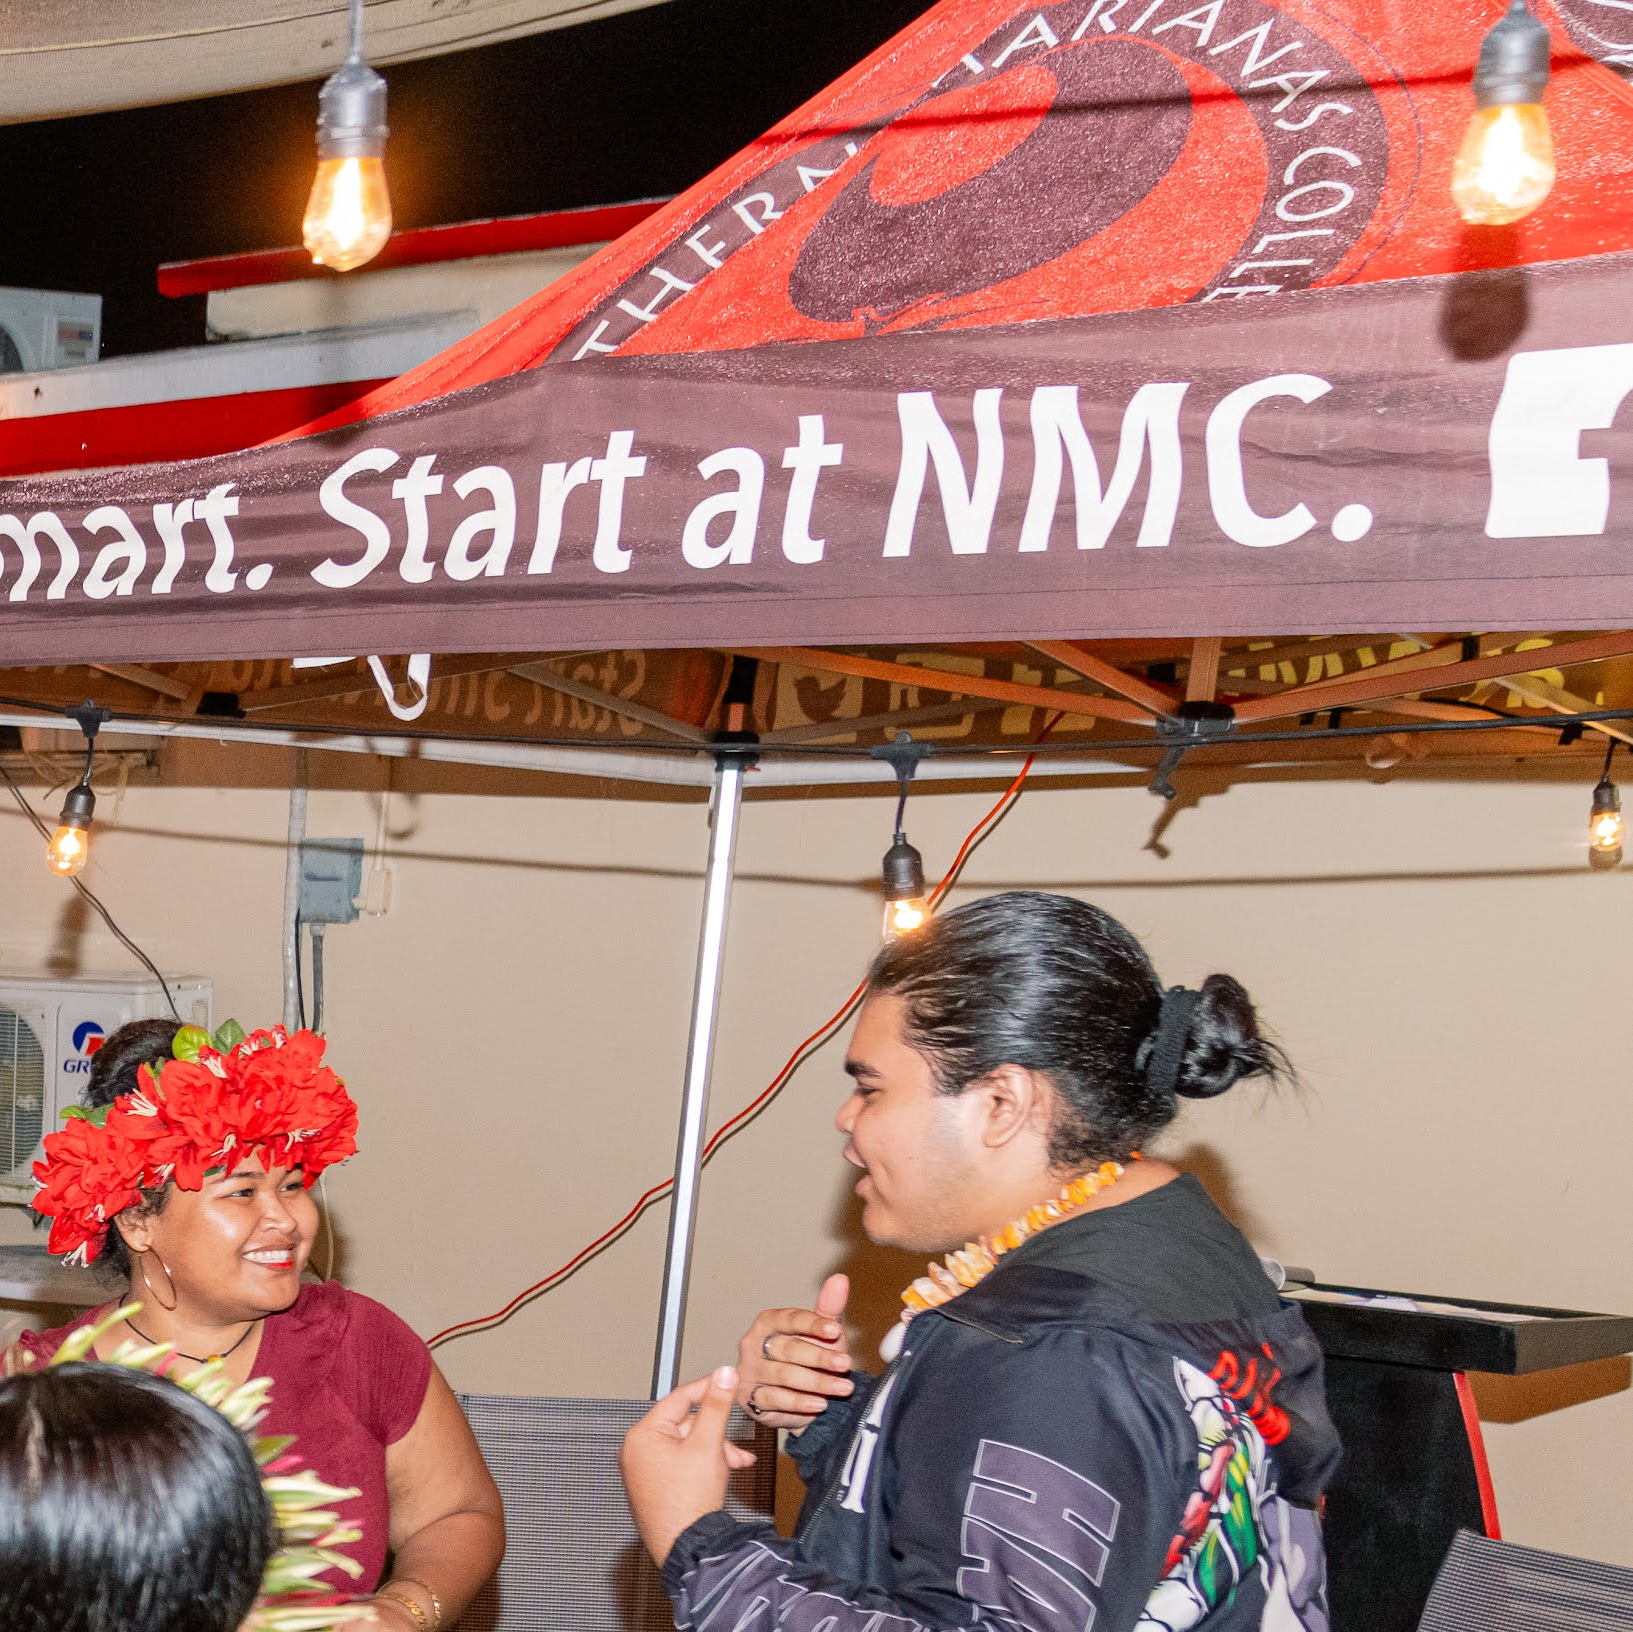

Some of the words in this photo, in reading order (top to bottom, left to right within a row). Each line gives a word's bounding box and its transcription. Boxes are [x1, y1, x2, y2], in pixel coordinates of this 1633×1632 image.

[310, 430, 647, 588] Start
[682, 414, 844, 568] at
[882, 373, 1374, 558] NMC.
